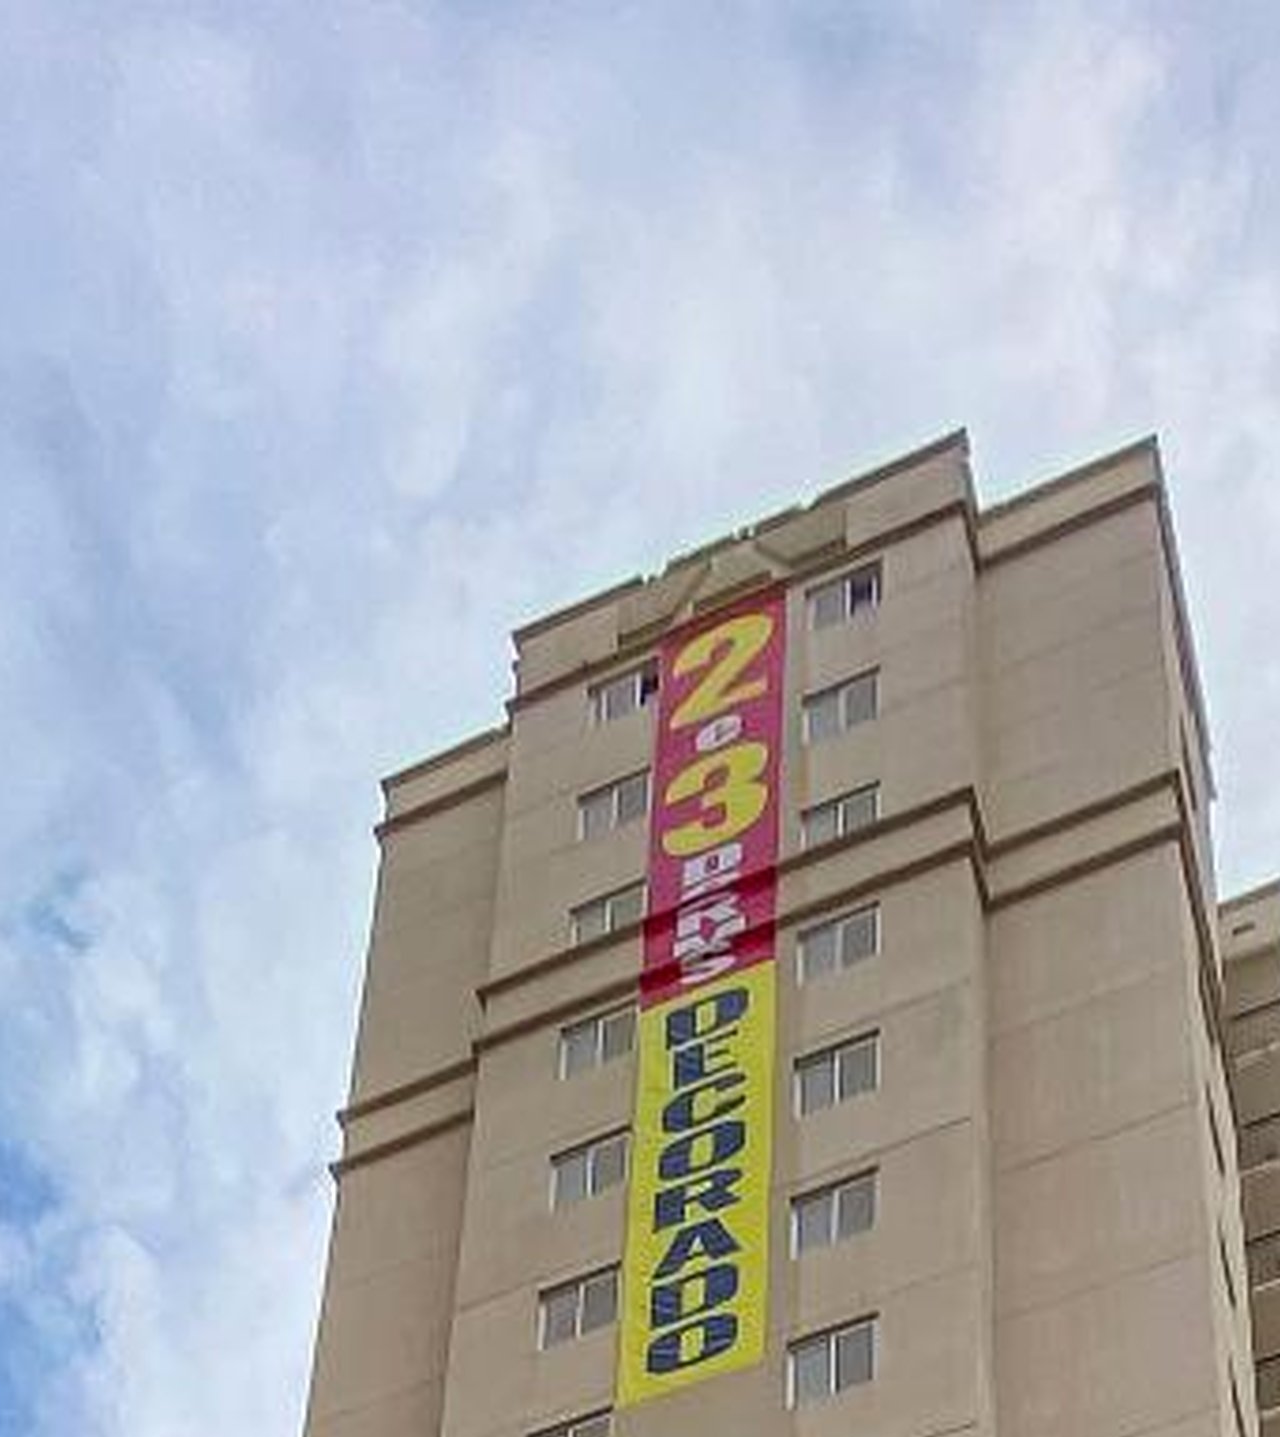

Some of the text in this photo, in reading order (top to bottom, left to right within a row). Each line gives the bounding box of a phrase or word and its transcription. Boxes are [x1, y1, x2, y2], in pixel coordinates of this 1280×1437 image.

[671, 613, 773, 729] 2
[663, 741, 769, 857] 3
[646, 986, 750, 1374] DECORADO
